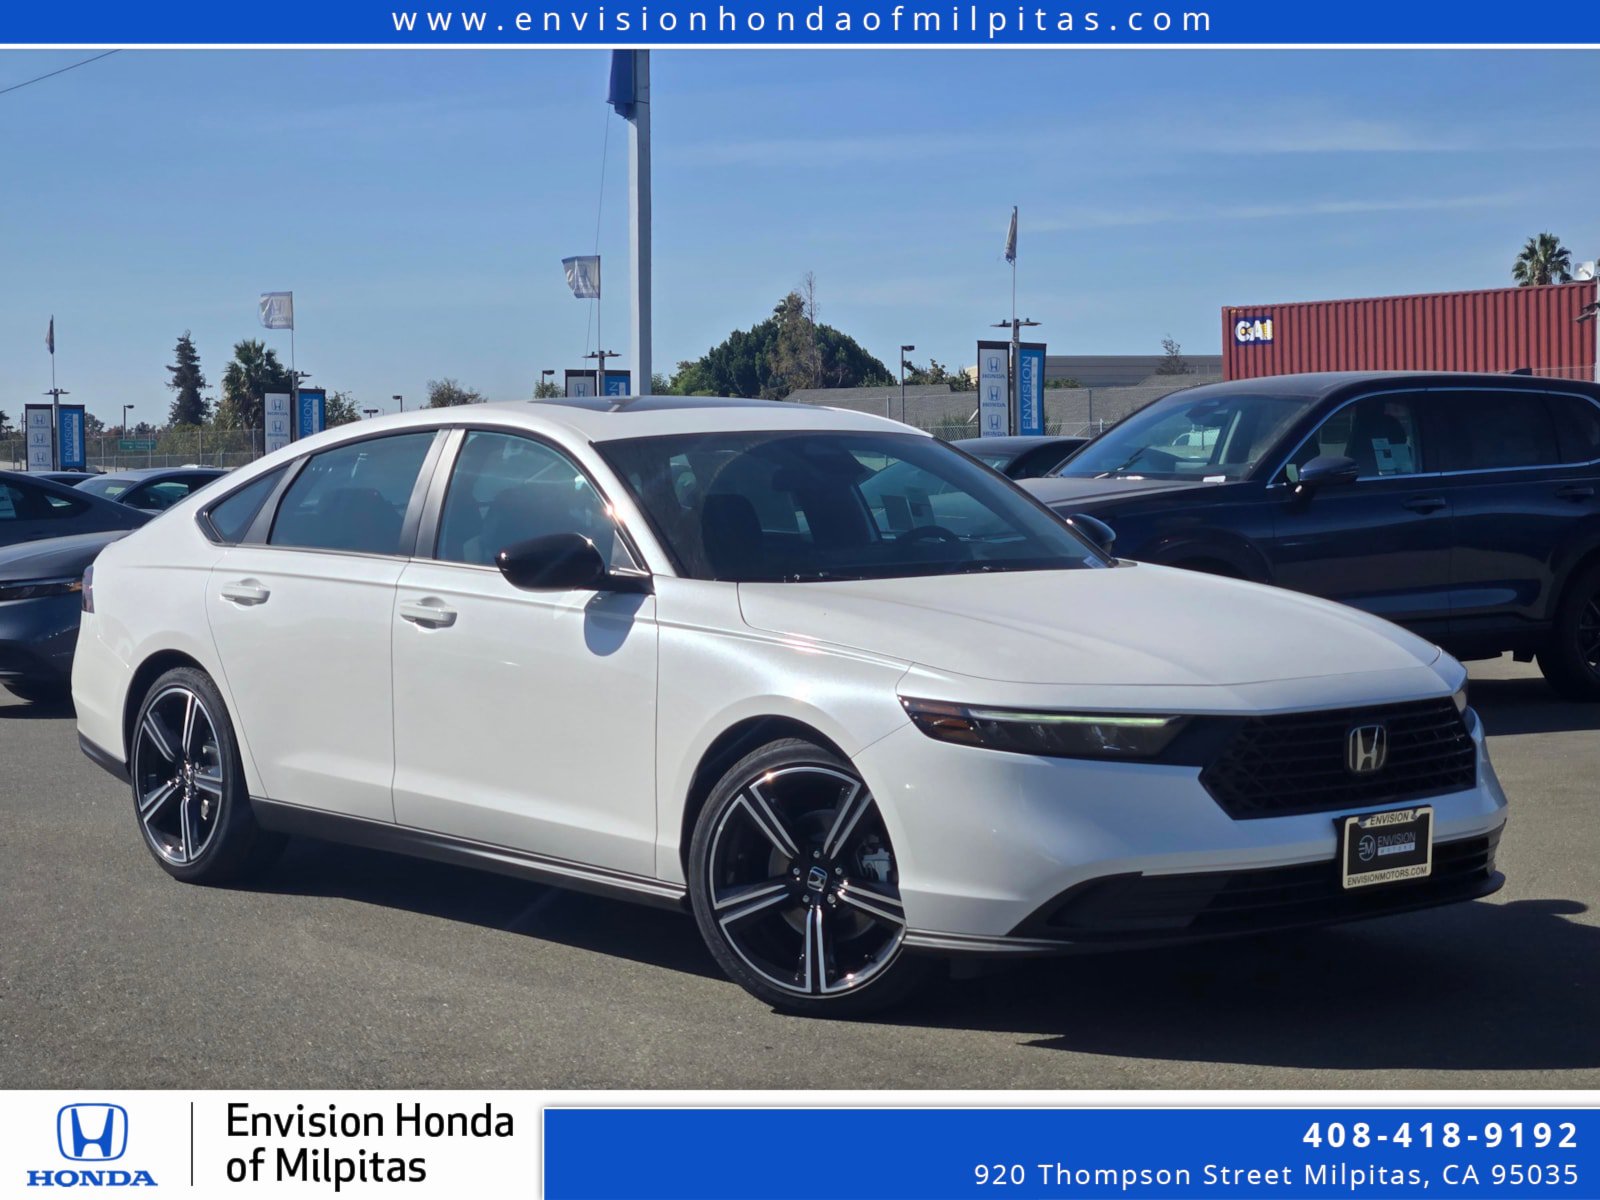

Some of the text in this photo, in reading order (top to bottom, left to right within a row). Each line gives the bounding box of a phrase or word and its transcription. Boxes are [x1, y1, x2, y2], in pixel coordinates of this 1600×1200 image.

[1234, 318, 1273, 342] CAI
[1022, 356, 1032, 430] ENVISION
[303, 398, 312, 435] VISION
[64, 413, 73, 463] ENVISION
[1369, 811, 1410, 826] ENVISION
[1377, 832, 1416, 847] ENVISION
[1347, 866, 1427, 886] ENVISIONMOTORS.COM
